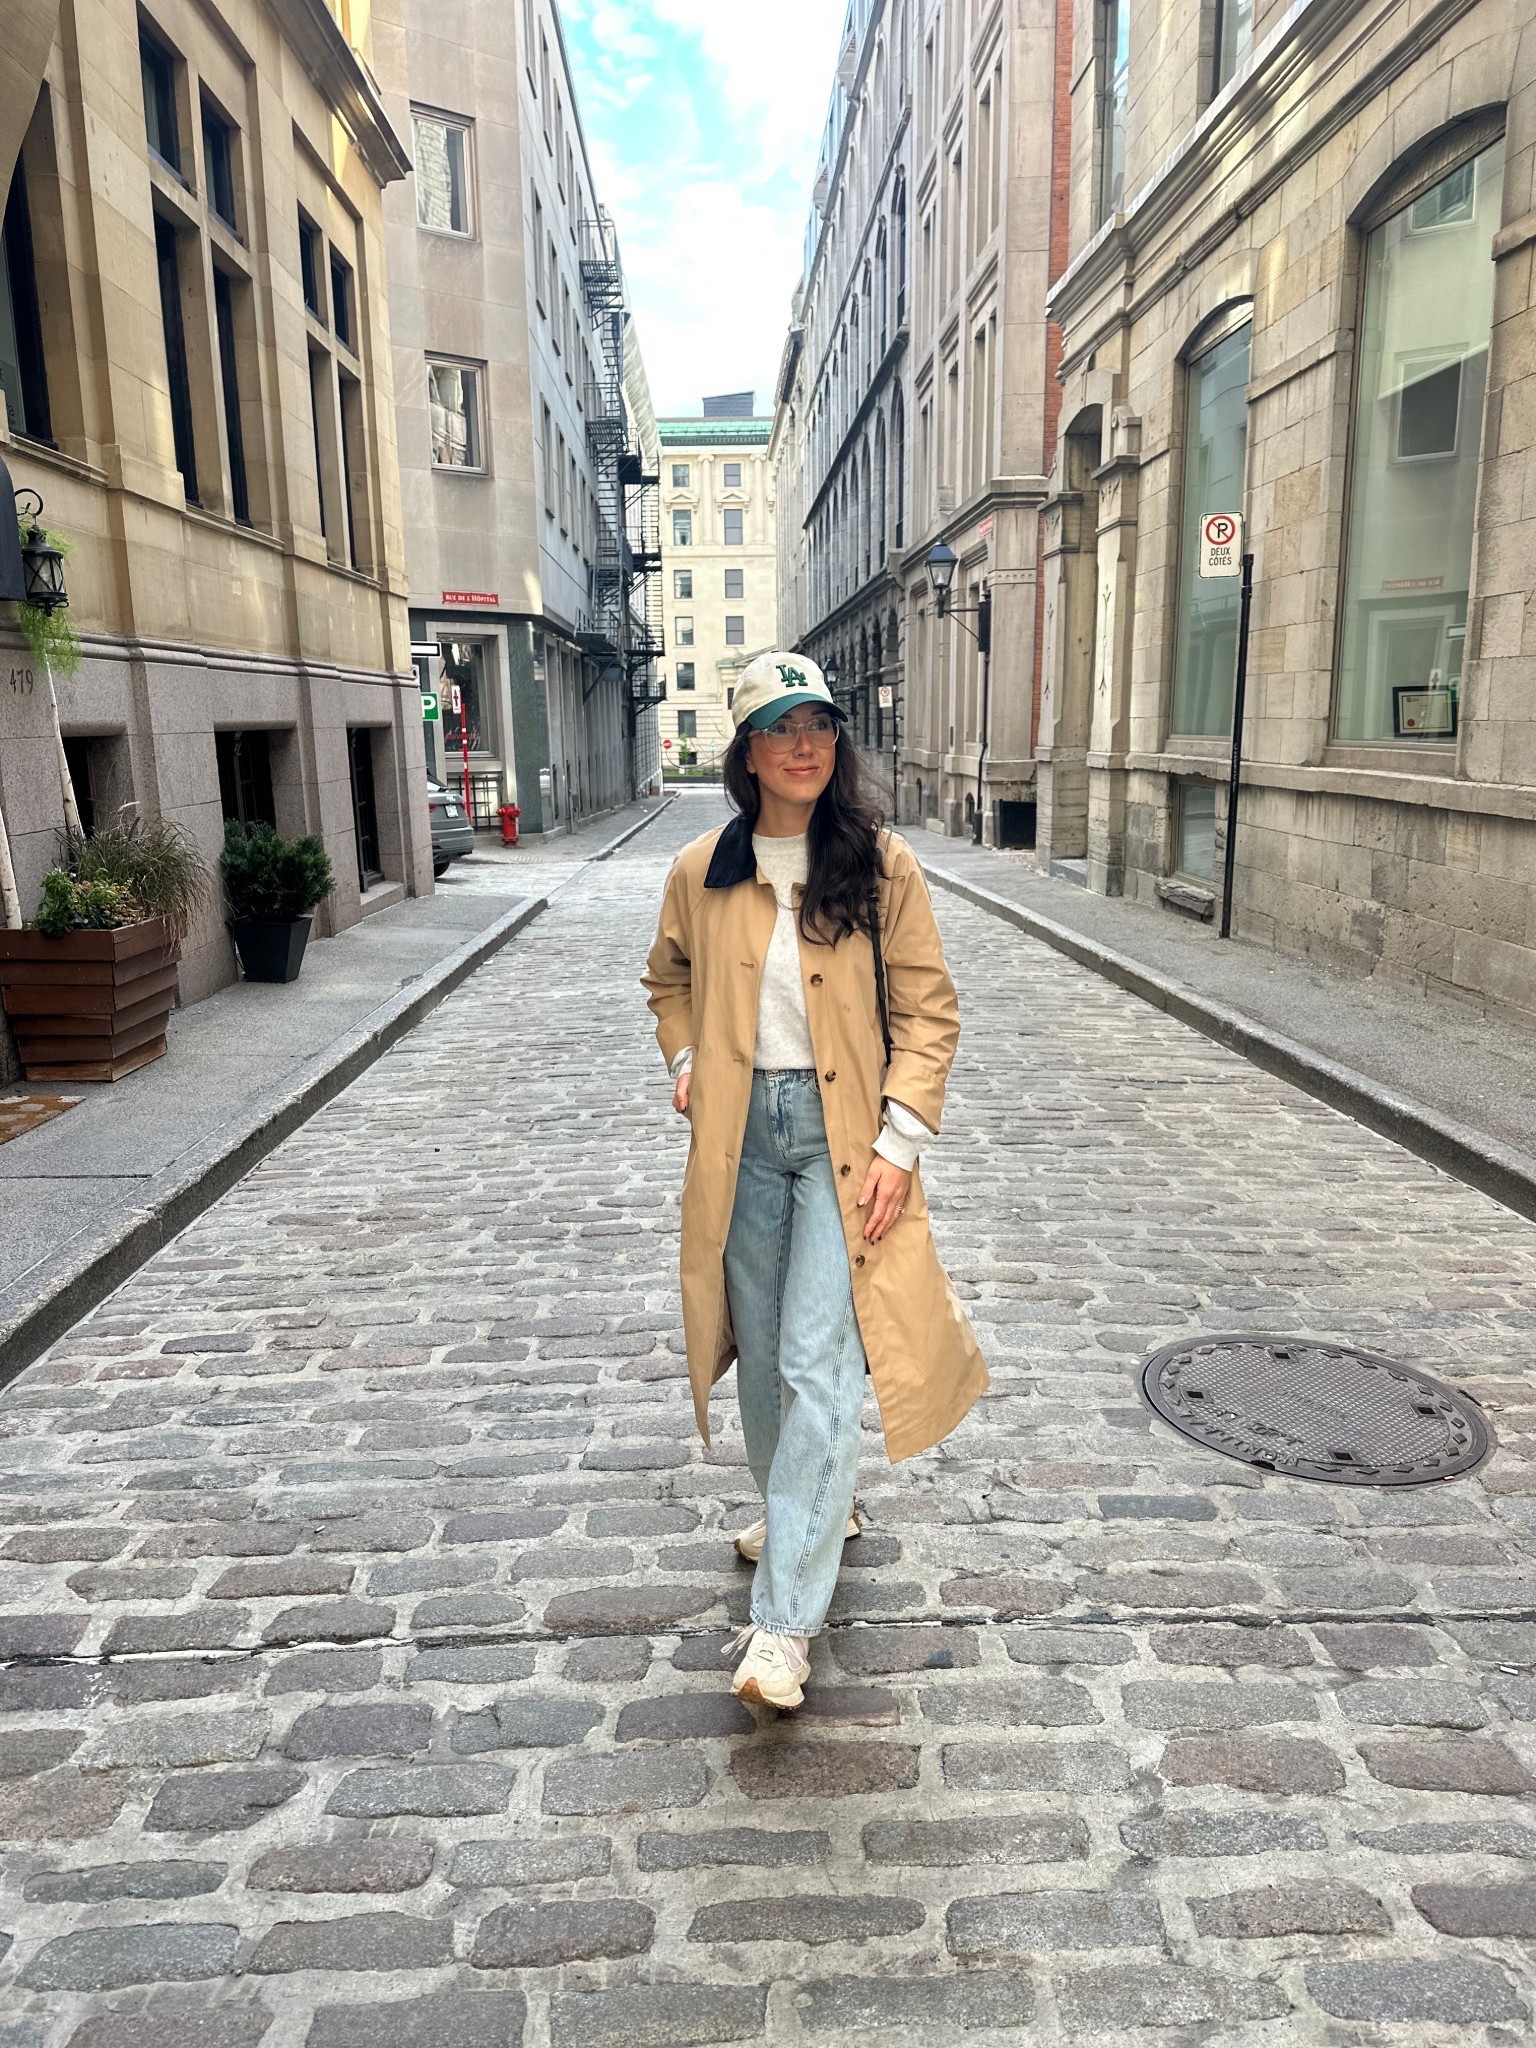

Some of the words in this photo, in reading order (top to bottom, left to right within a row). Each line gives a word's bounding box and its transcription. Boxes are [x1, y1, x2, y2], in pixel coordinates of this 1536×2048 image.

[1210, 547, 1231, 556] DEUX
[10, 668, 33, 695] 479
[775, 664, 808, 687] LA
[421, 695, 437, 718] P
